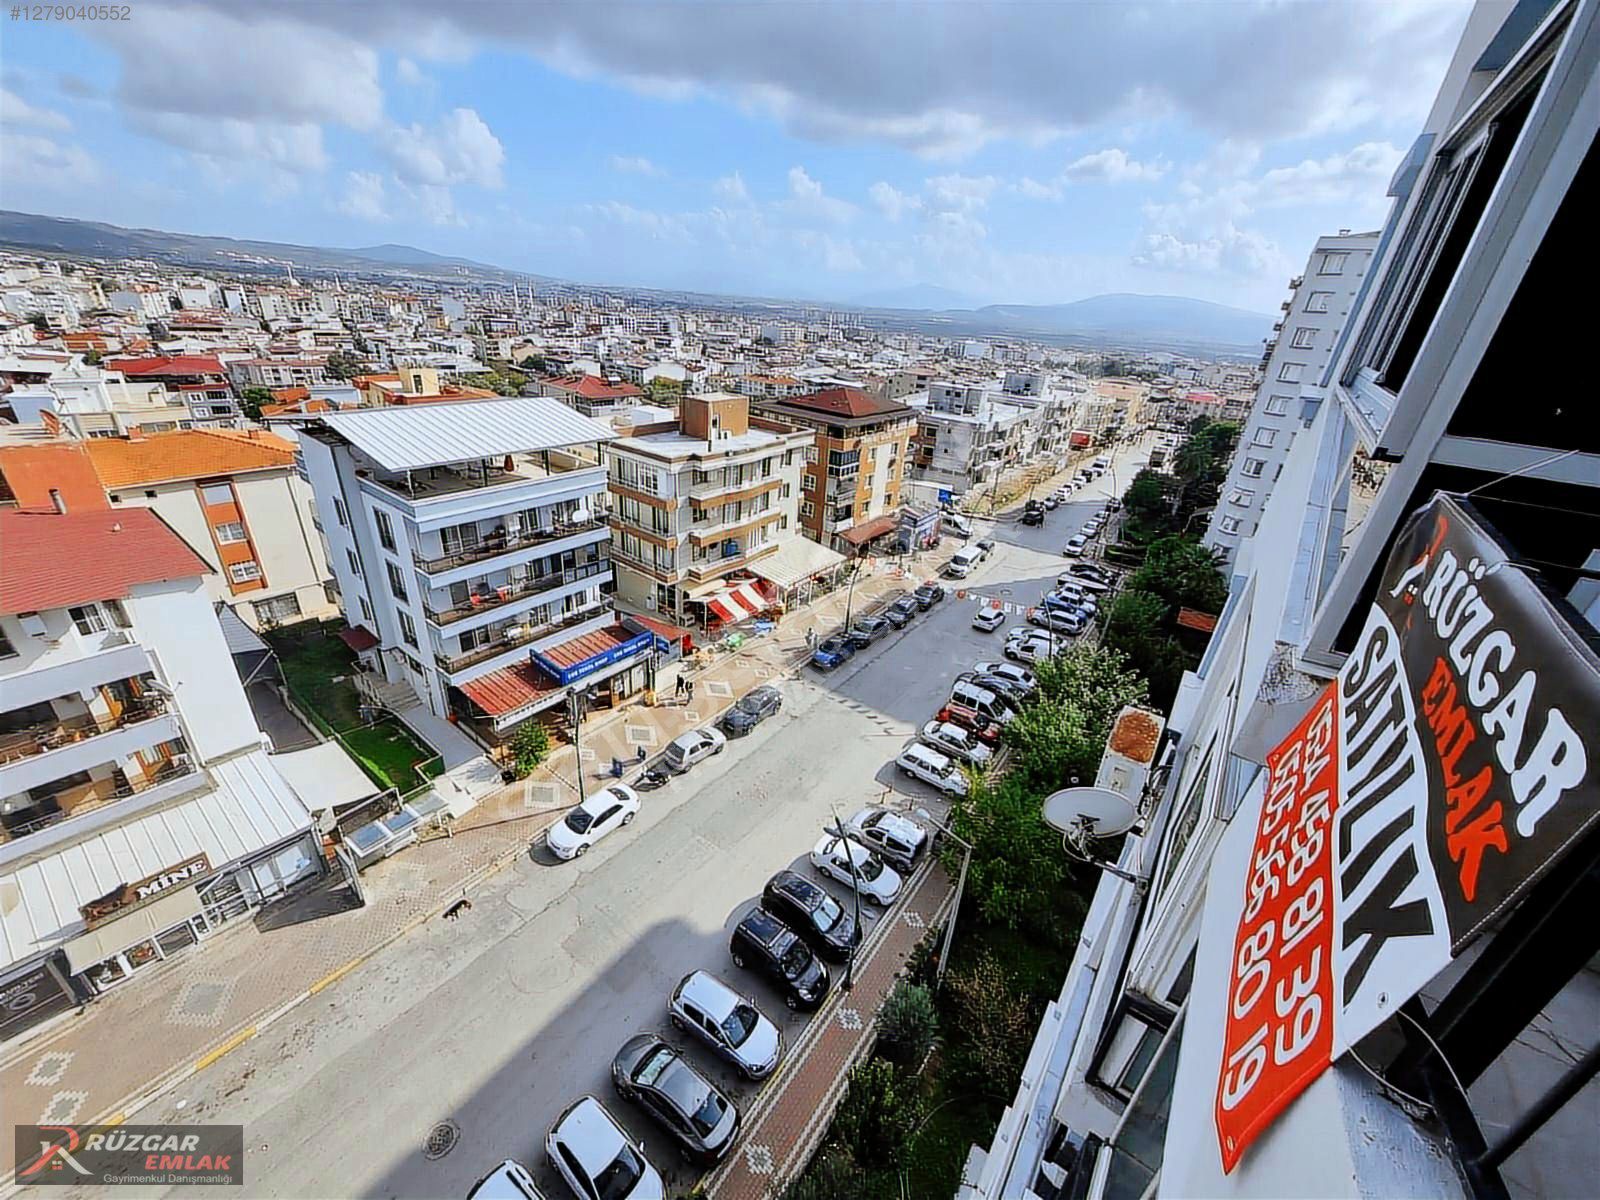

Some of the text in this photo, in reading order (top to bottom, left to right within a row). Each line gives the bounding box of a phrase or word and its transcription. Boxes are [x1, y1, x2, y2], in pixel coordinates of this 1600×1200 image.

[1421, 656, 1509, 902] EMLAK
[1423, 549, 1587, 838] RÜZGAR
[1263, 741, 1303, 835] 0505
[1340, 625, 1434, 1014] SATILIK
[137, 859, 209, 900] MİNE
[1274, 699, 1332, 1067] 0534 458 81 39
[1233, 919, 1275, 1021] 80
[1222, 1021, 1270, 1111] 19
